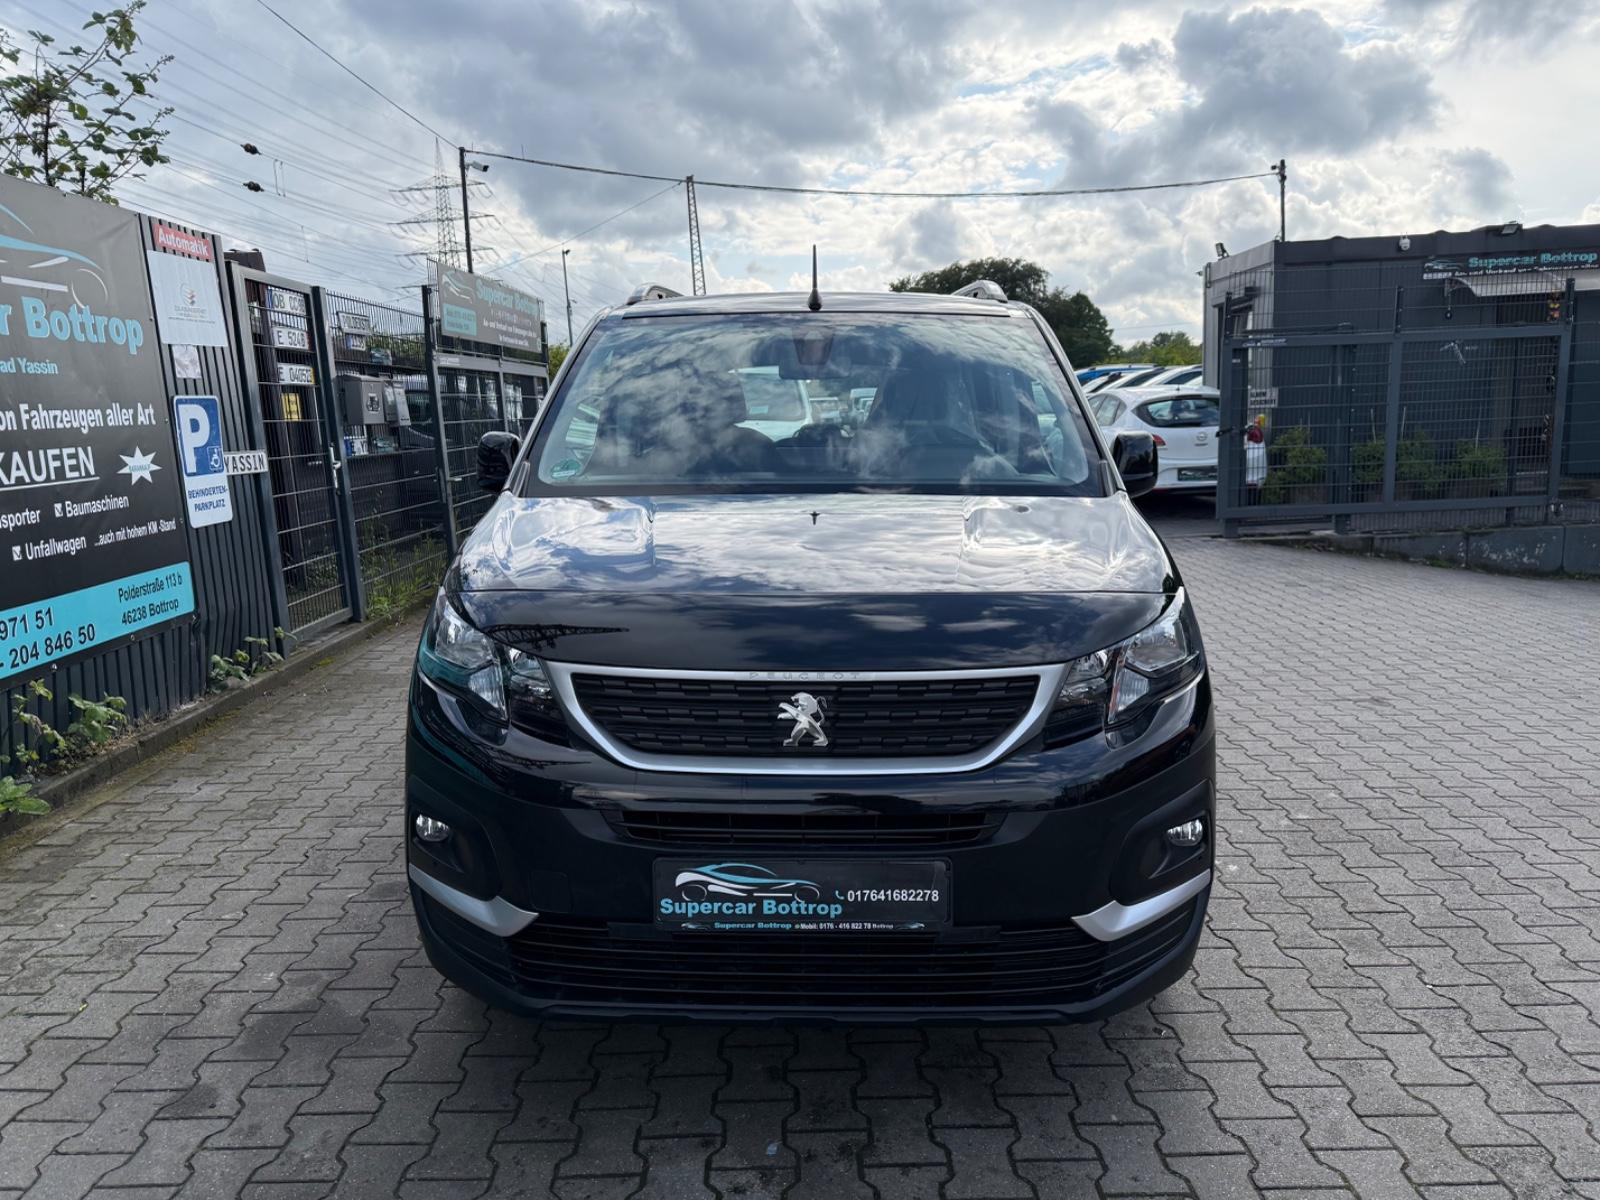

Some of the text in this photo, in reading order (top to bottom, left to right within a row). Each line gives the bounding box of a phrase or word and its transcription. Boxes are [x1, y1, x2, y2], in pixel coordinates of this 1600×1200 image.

[158, 226, 209, 257] Automatik
[1468, 252, 1598, 269] Supercar Bottrop
[21, 296, 144, 355] Bottrop
[0, 357, 59, 374] ad Yassin
[19, 403, 104, 434] Fahrzeugen
[106, 402, 134, 427] aller
[137, 402, 156, 426] Art
[178, 403, 210, 474] P
[224, 453, 265, 473] YASSIN
[188, 485, 228, 499] BEHINDERTEN-
[194, 499, 226, 512] PARKPLATZ
[0, 494, 130, 531] sporter Baumaschinen
[25, 536, 87, 560] Unfallwagen
[115, 527, 127, 541] mit
[126, 525, 148, 539] hohem
[118, 571, 183, 603] Polderstraße 113 b
[0, 606, 53, 640] 971 51
[121, 598, 179, 625] 46238 Bottrop
[9, 641, 40, 669] 204
[44, 631, 74, 656] 846
[78, 623, 96, 645] 50
[749, 671, 860, 680] PEUGEOT
[660, 898, 843, 918] Supercar Bottrop
[847, 889, 939, 902] 017641682278
[714, 921, 755, 930] Supercar
[757, 921, 792, 930] Bottrop
[819, 922, 834, 930] 0176
[851, 922, 862, 930] 822
[863, 922, 872, 930] 78
